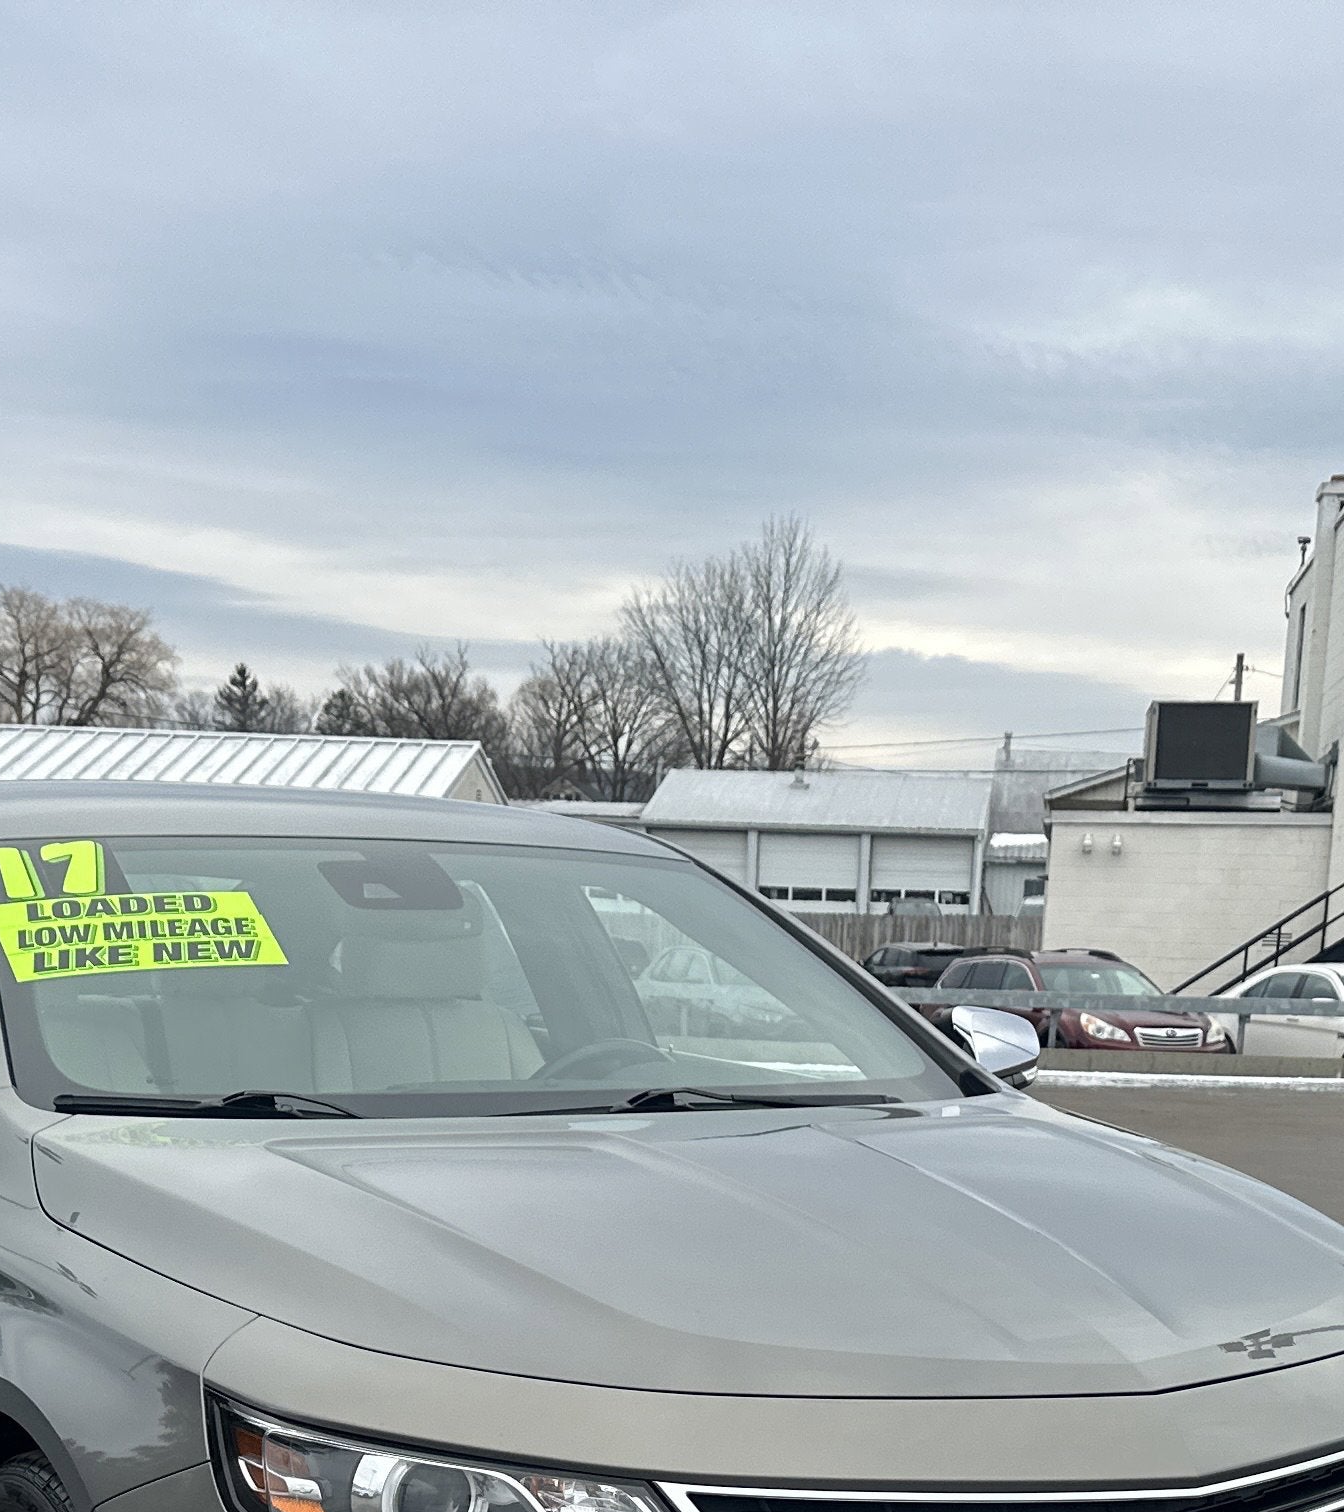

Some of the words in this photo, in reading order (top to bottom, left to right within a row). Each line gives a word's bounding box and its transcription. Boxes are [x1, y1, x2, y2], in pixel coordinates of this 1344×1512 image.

[26, 894, 217, 923] LOADED
[17, 923, 97, 949] LOW
[102, 917, 259, 942] MILEAGE
[32, 944, 140, 974] LIKE
[153, 940, 261, 965] NEW
